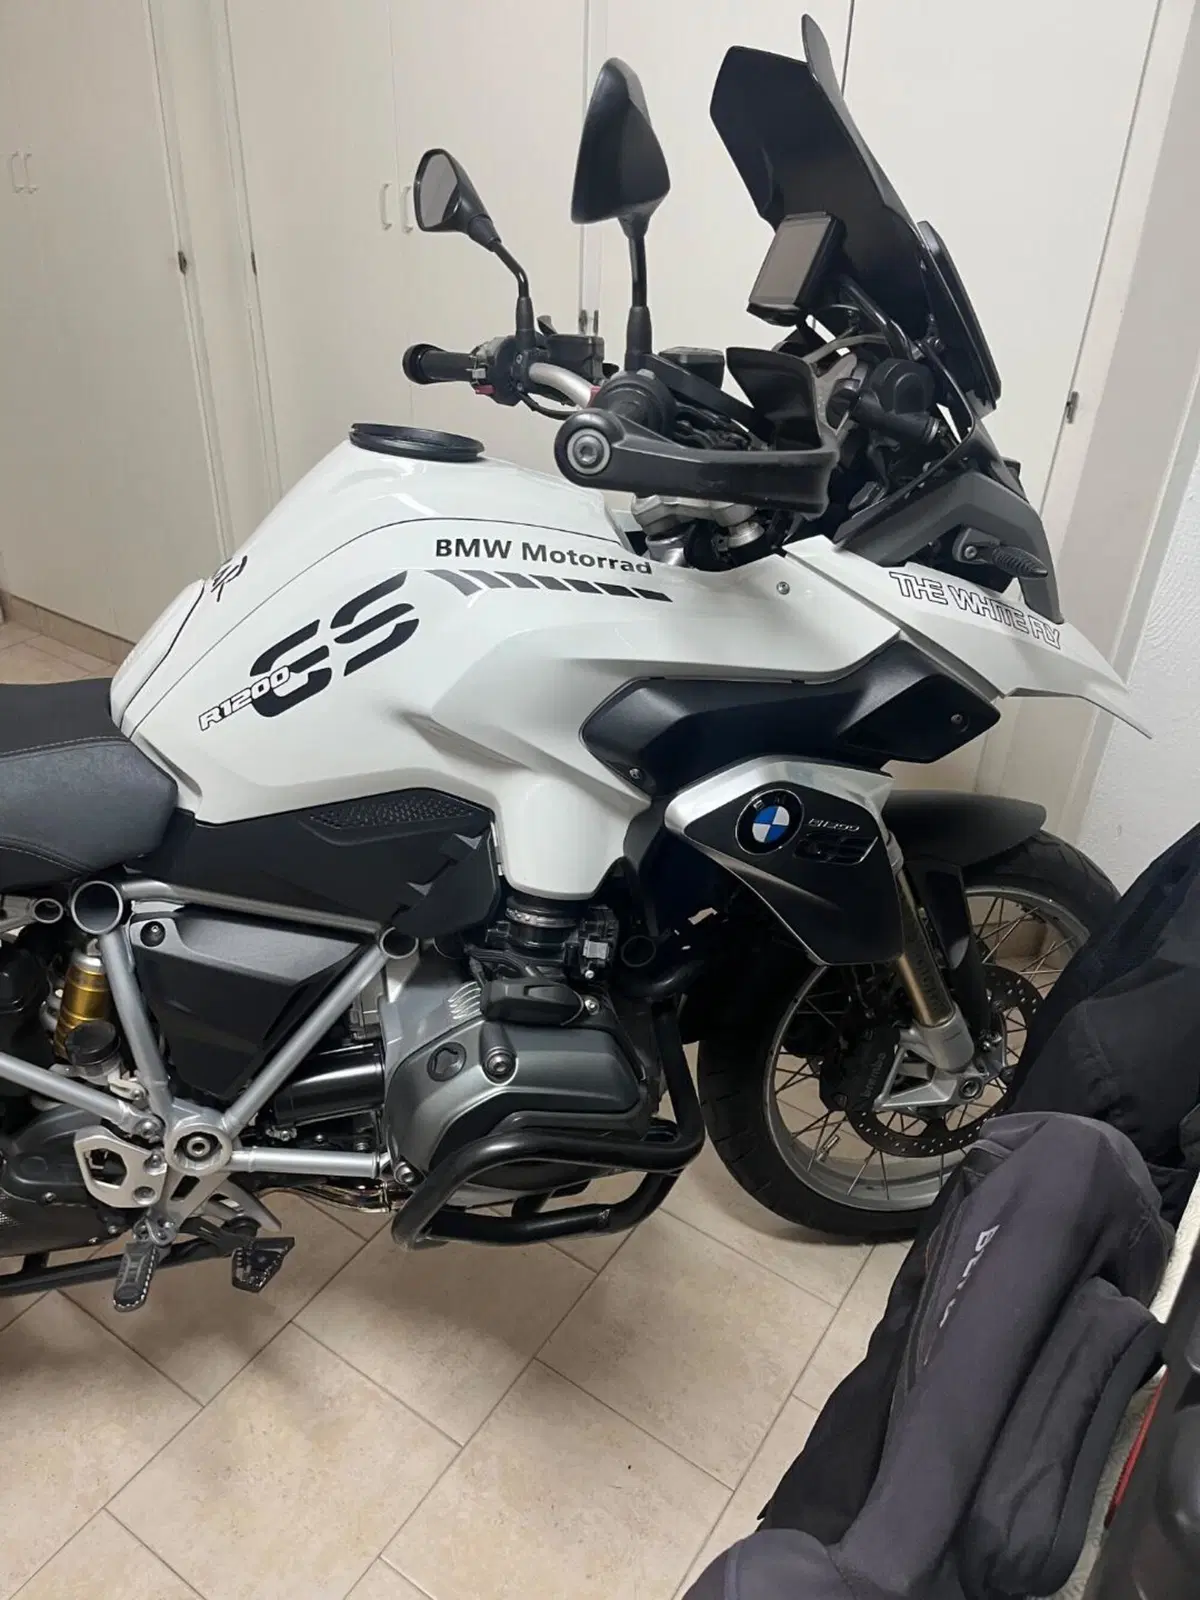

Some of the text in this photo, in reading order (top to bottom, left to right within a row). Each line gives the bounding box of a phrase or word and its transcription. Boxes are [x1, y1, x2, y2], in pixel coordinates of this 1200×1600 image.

[435, 538, 653, 575] BMW Motorrad
[250, 569, 419, 718] GS
[889, 571, 1061, 650] THE WHITE FLY
[199, 665, 290, 732] R1200
